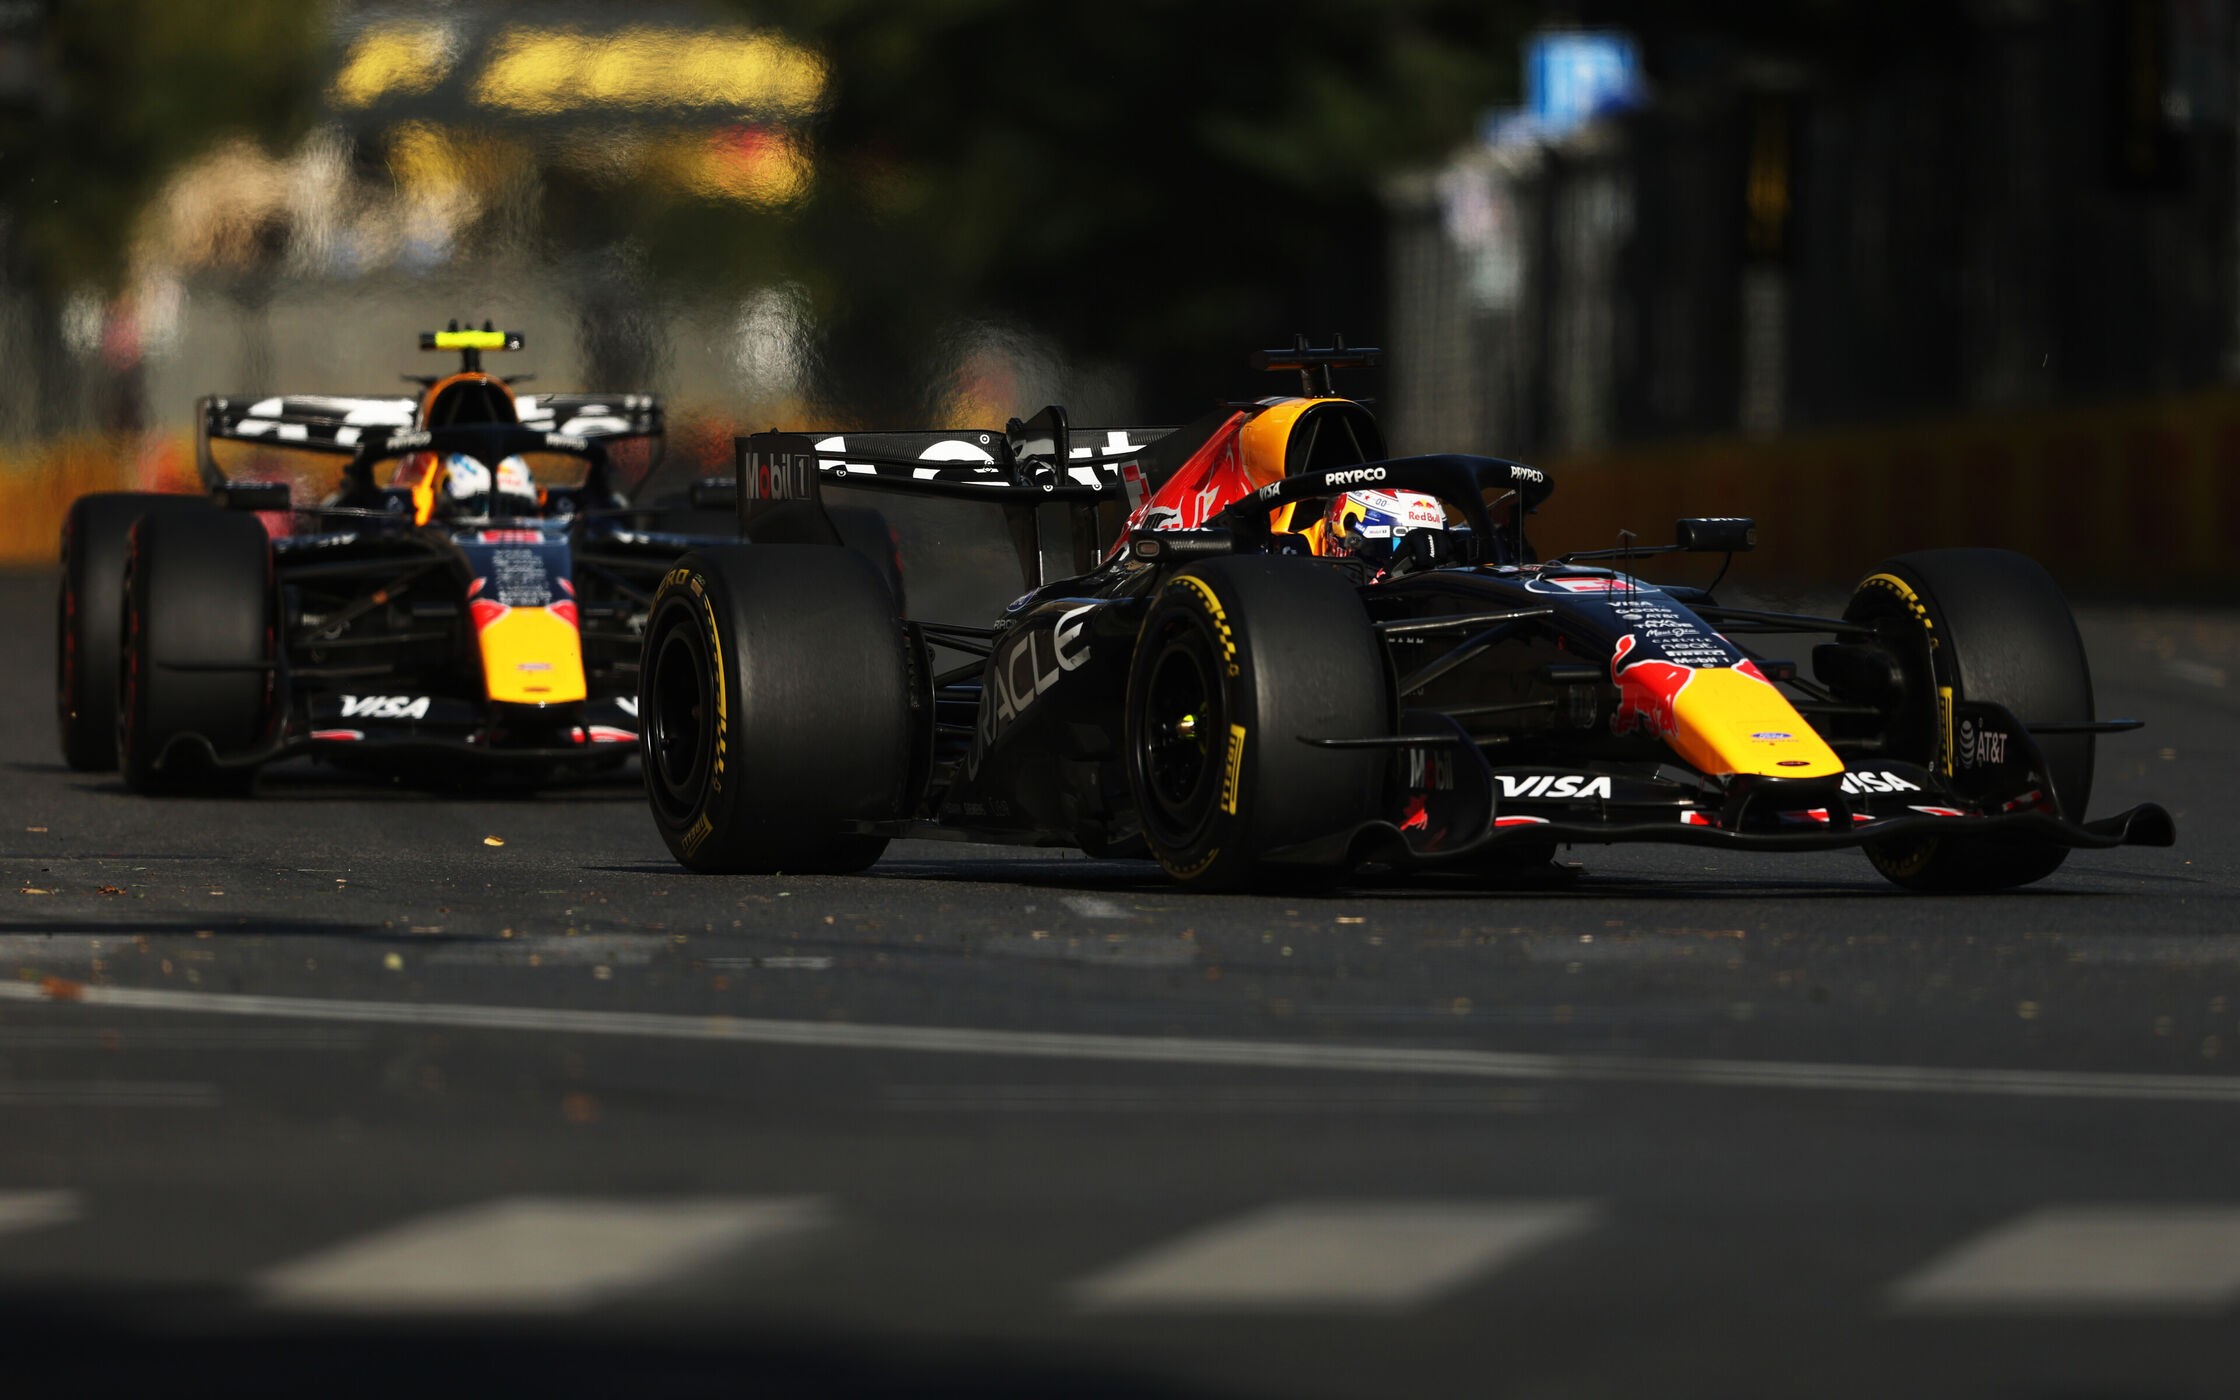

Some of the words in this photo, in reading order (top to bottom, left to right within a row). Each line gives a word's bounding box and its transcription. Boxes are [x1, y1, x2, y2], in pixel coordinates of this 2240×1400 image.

[745, 452, 793, 500] Mobil
[1325, 467, 1387, 487] PRYPCO
[1511, 465, 1544, 484] PRYPCO
[1258, 481, 1281, 502] VISA
[1408, 511, 1426, 521] Red
[1427, 512, 1441, 523] Bull
[1672, 656, 1718, 664] Mobil
[339, 695, 431, 720] VISA
[1975, 730, 2009, 765] AT&T
[1220, 723, 1247, 816] PIRELLI
[1409, 748, 1454, 791] Mobil
[1494, 775, 1612, 800] VISA
